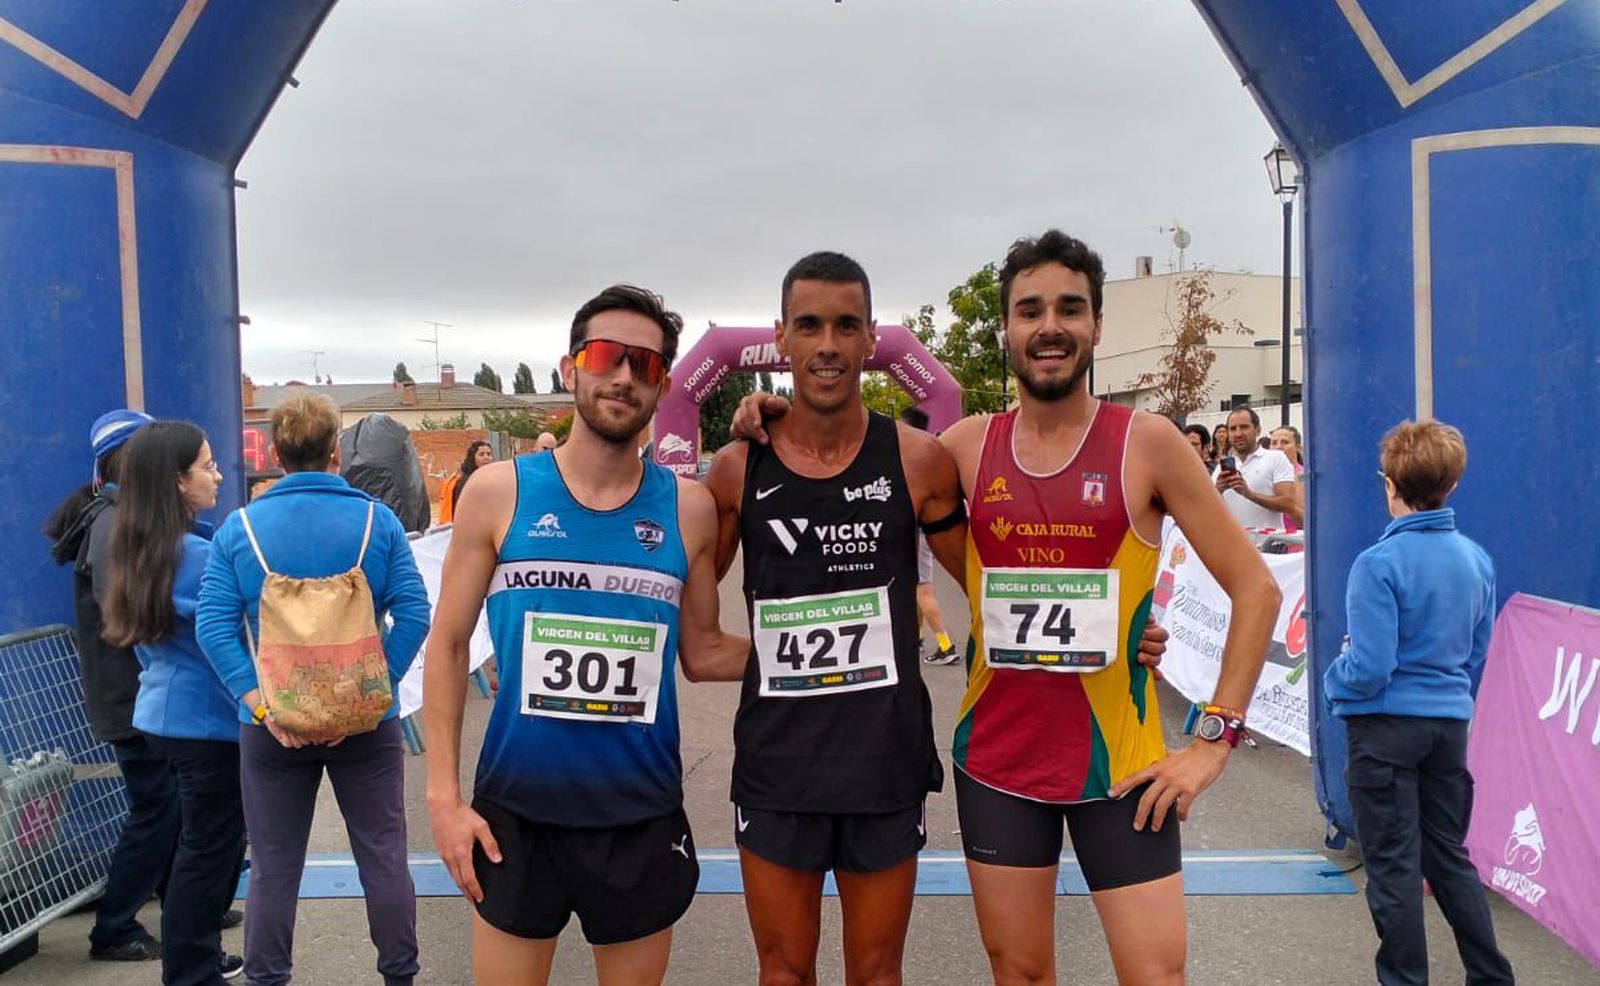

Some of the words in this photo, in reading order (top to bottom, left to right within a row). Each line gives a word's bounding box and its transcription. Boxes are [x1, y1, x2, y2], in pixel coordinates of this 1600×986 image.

[684, 356, 714, 392] somos
[889, 361, 929, 401] deporte
[902, 351, 937, 385] somos
[693, 364, 730, 404] deporte
[814, 522, 883, 541] VICKY
[1016, 523, 1050, 538] CAJA
[1050, 524, 1096, 538] RURAL
[822, 542, 877, 556] FOODS
[1018, 548, 1065, 563] VINO
[828, 563, 875, 573] ATHLETICS
[504, 570, 592, 589] LAGUNA
[603, 575, 675, 601] DUERO
[990, 583, 1029, 593] VIRGEN
[1032, 582, 1055, 593] DEL
[1058, 583, 1101, 593] VILLAR
[764, 611, 804, 624] VIRGEN
[806, 607, 831, 620] DEL
[830, 602, 873, 616] VILLAR
[1009, 603, 1076, 645] 74
[537, 626, 582, 641] VIRGEN
[584, 630, 609, 644] DEL
[612, 633, 651, 646] VILLAR
[776, 623, 869, 671] 427
[542, 648, 638, 697] 301
